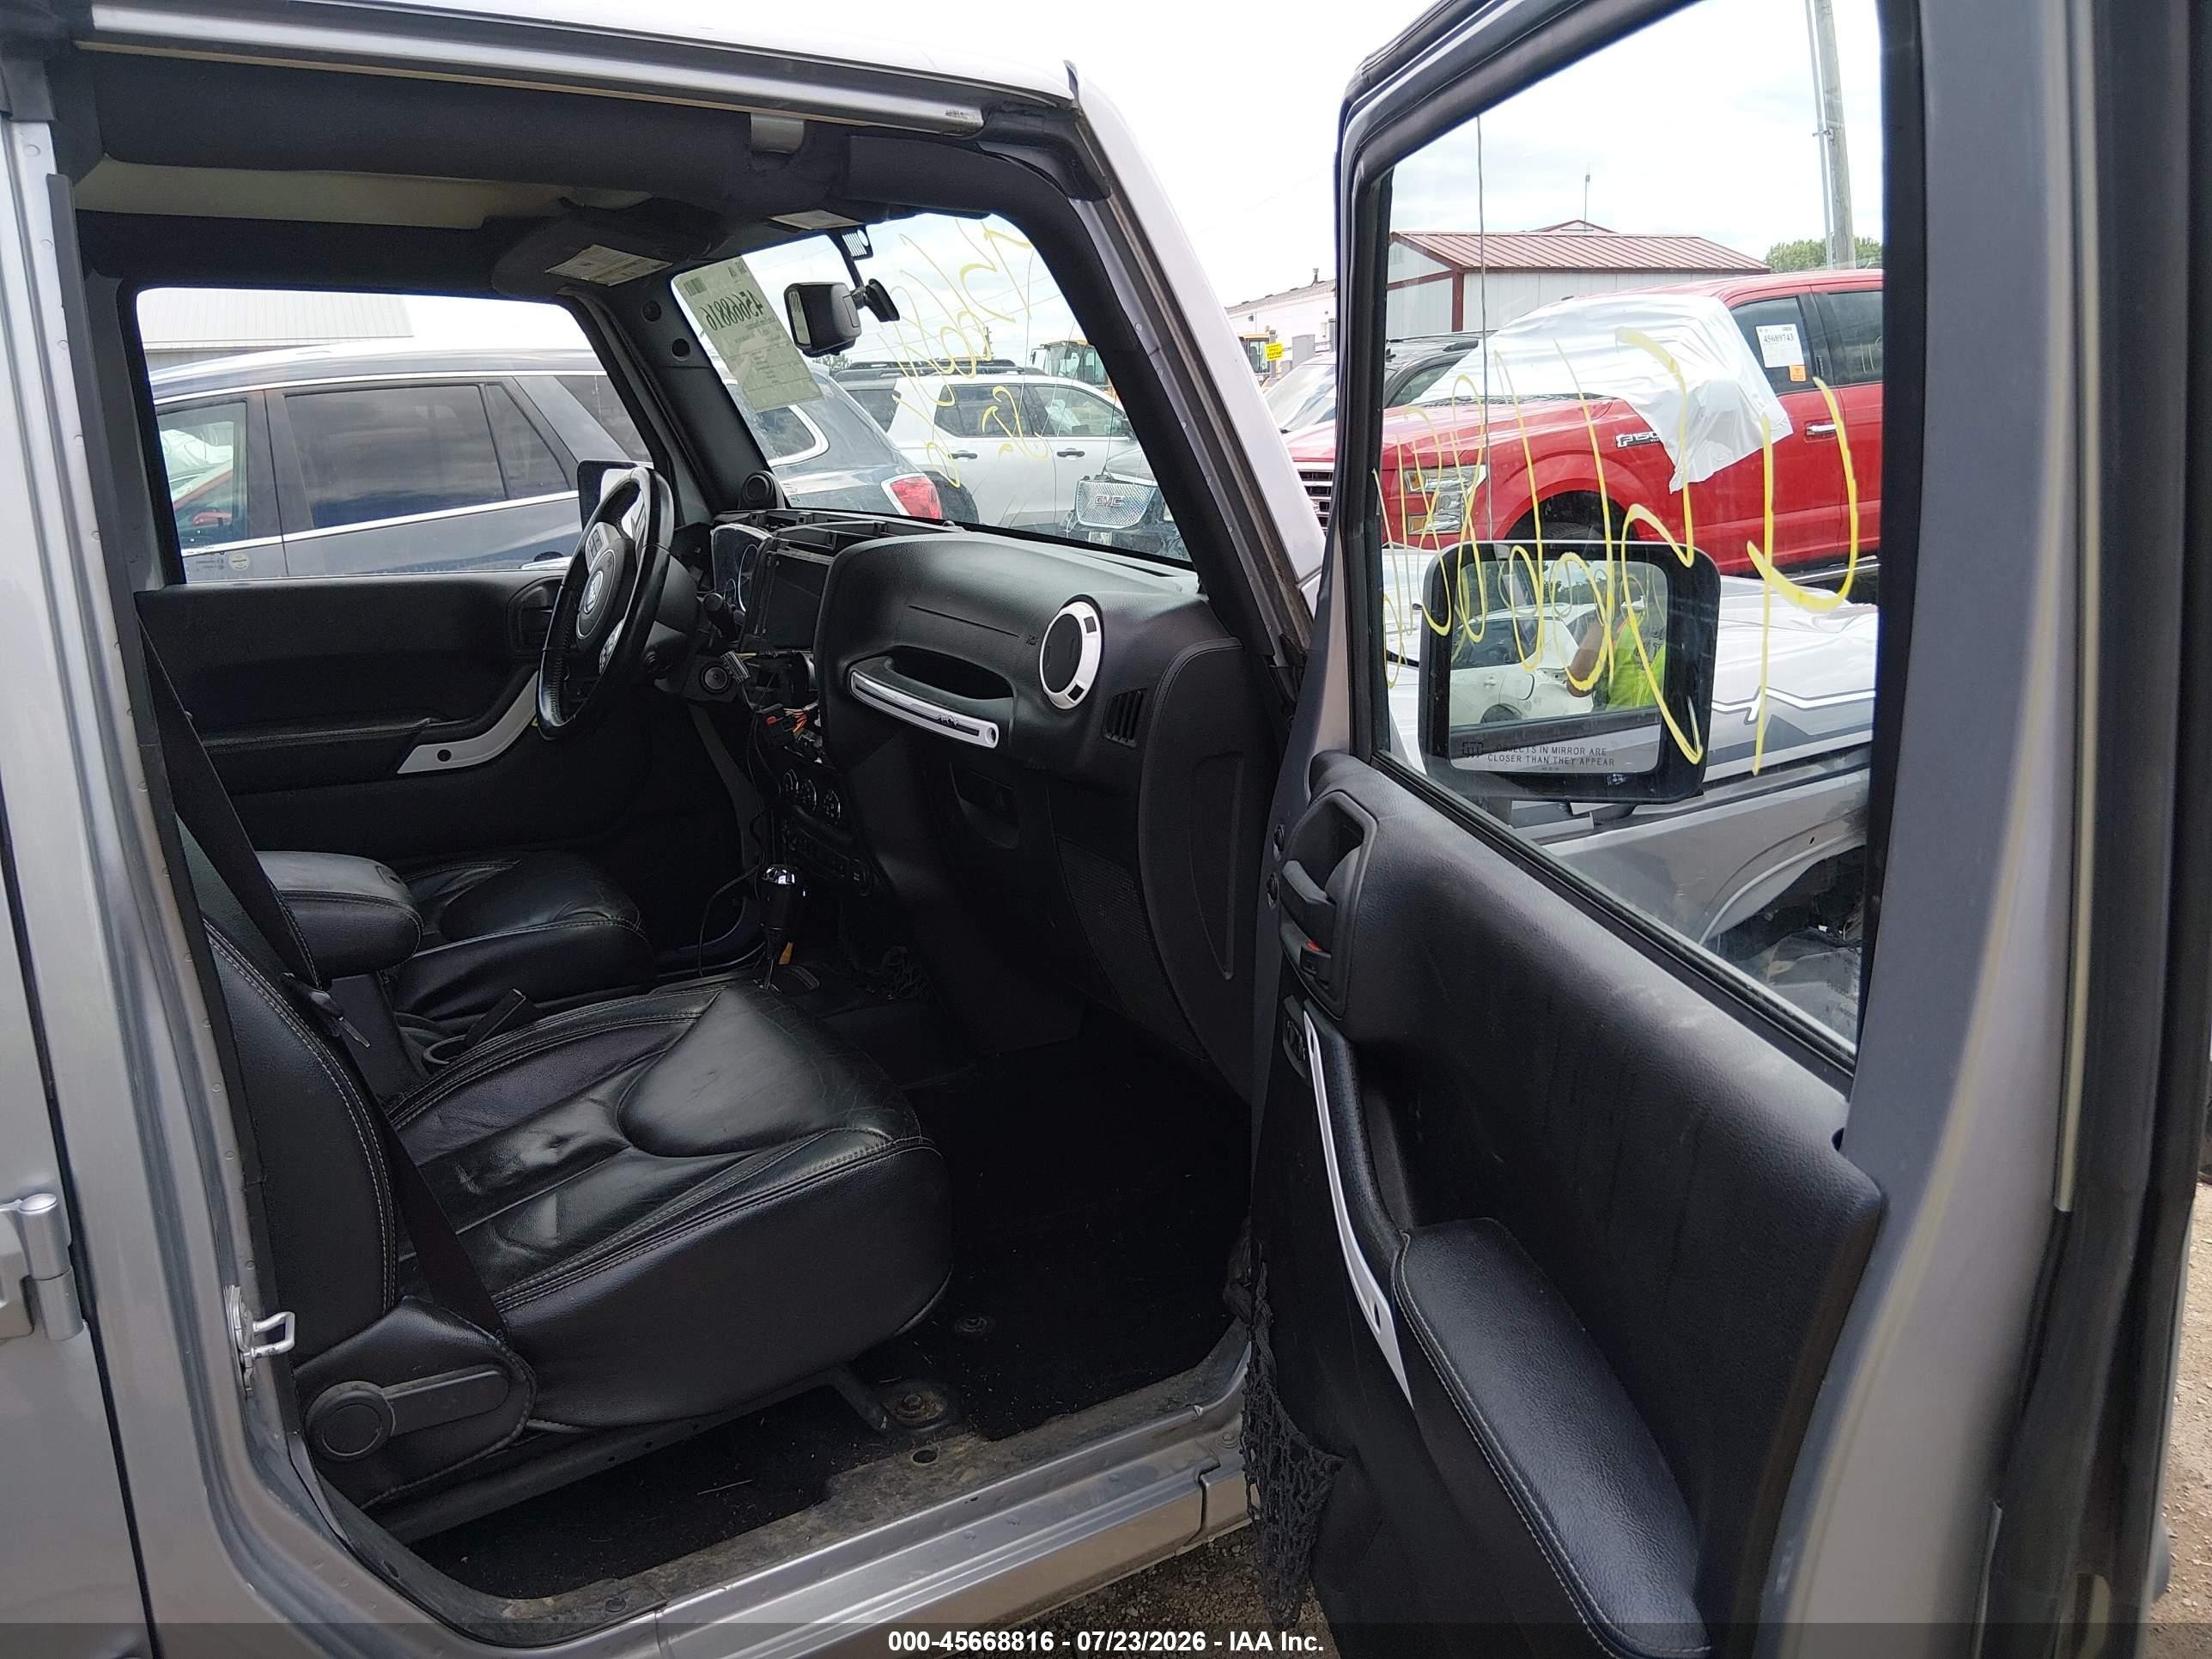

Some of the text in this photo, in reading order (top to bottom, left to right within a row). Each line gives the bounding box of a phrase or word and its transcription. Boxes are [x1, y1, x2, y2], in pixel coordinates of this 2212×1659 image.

[1094, 494, 1123, 507] GMC
[1539, 745, 1549, 755] IN
[1551, 745, 1585, 756] MIRROR
[1589, 747, 1607, 757] ARE
[1487, 754, 1615, 766] CLOSER THAN THEY APPEAR
